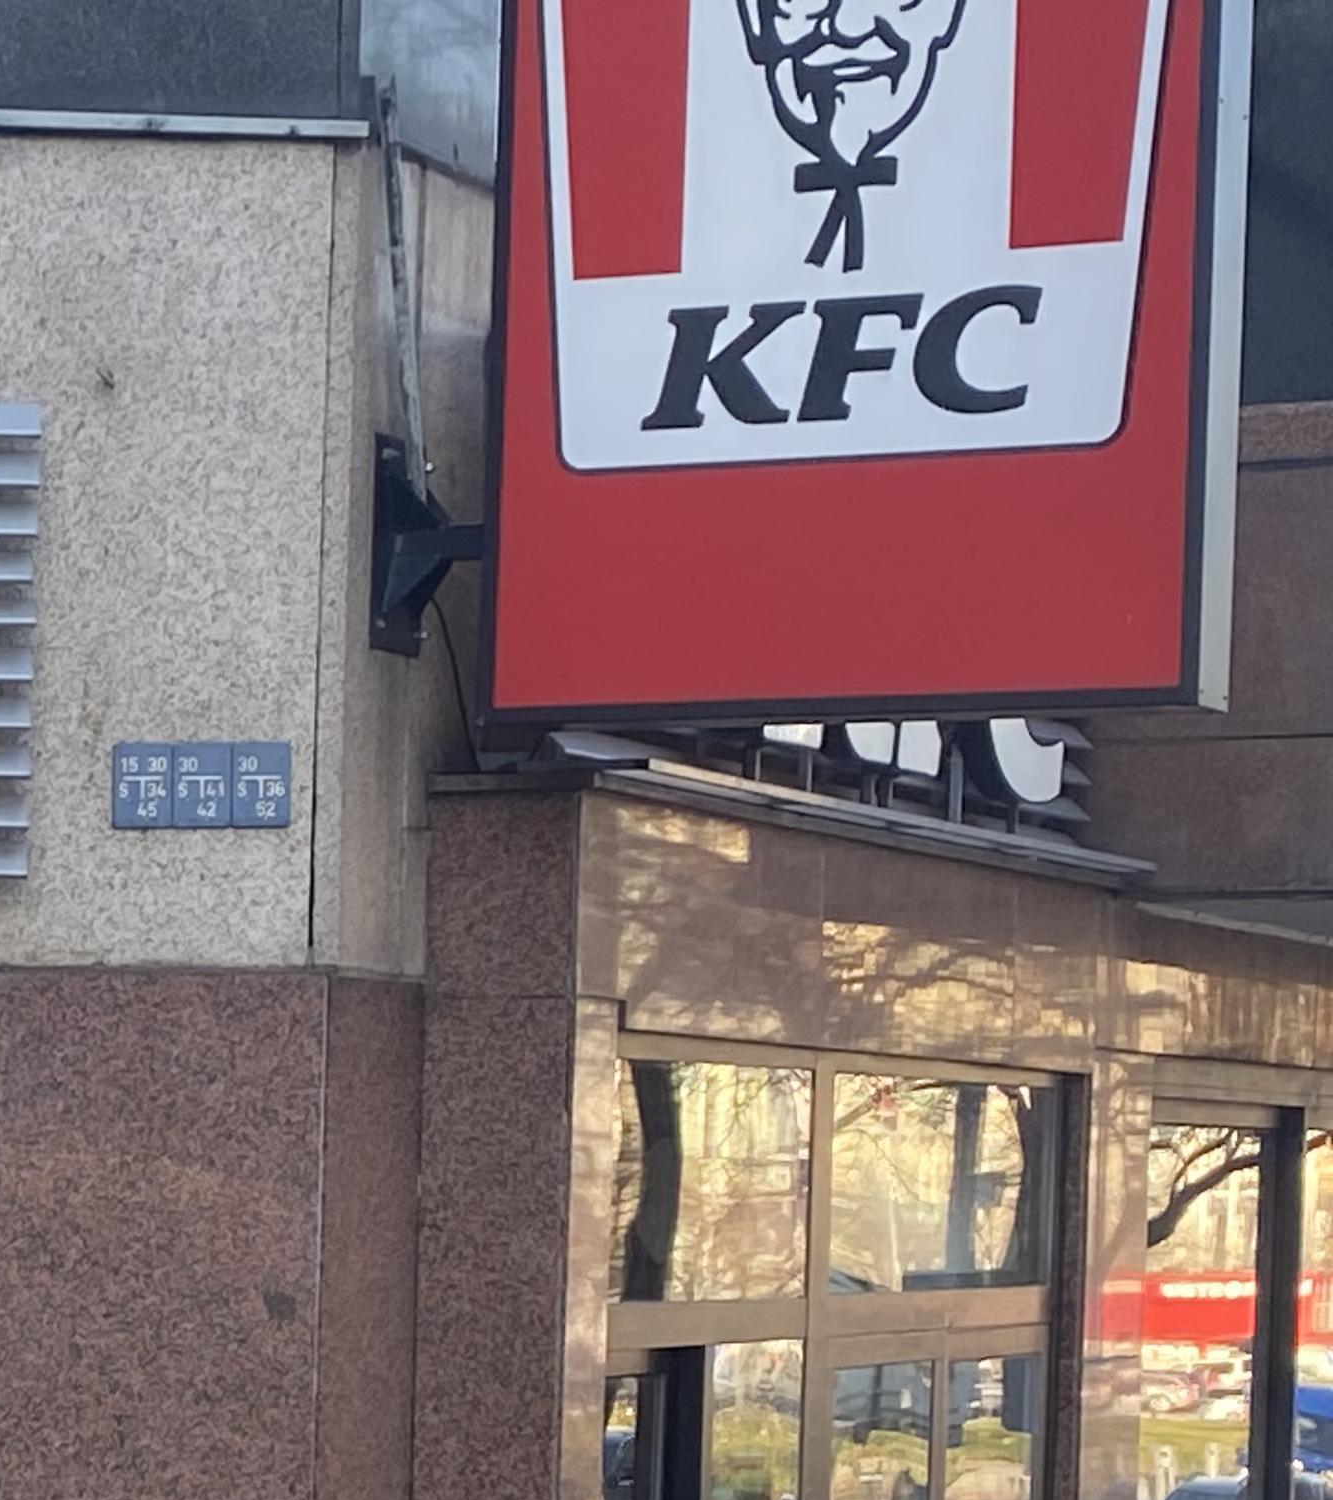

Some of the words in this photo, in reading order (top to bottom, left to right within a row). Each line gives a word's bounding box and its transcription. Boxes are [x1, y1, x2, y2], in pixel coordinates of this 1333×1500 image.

[641, 285, 1042, 432] KFC
[120, 756, 138, 773] 15
[147, 756, 168, 773] 30
[178, 756, 198, 773] 30
[238, 756, 258, 773] 30
[266, 782, 286, 797] 36
[137, 801, 158, 818] 45
[196, 801, 217, 818] 42
